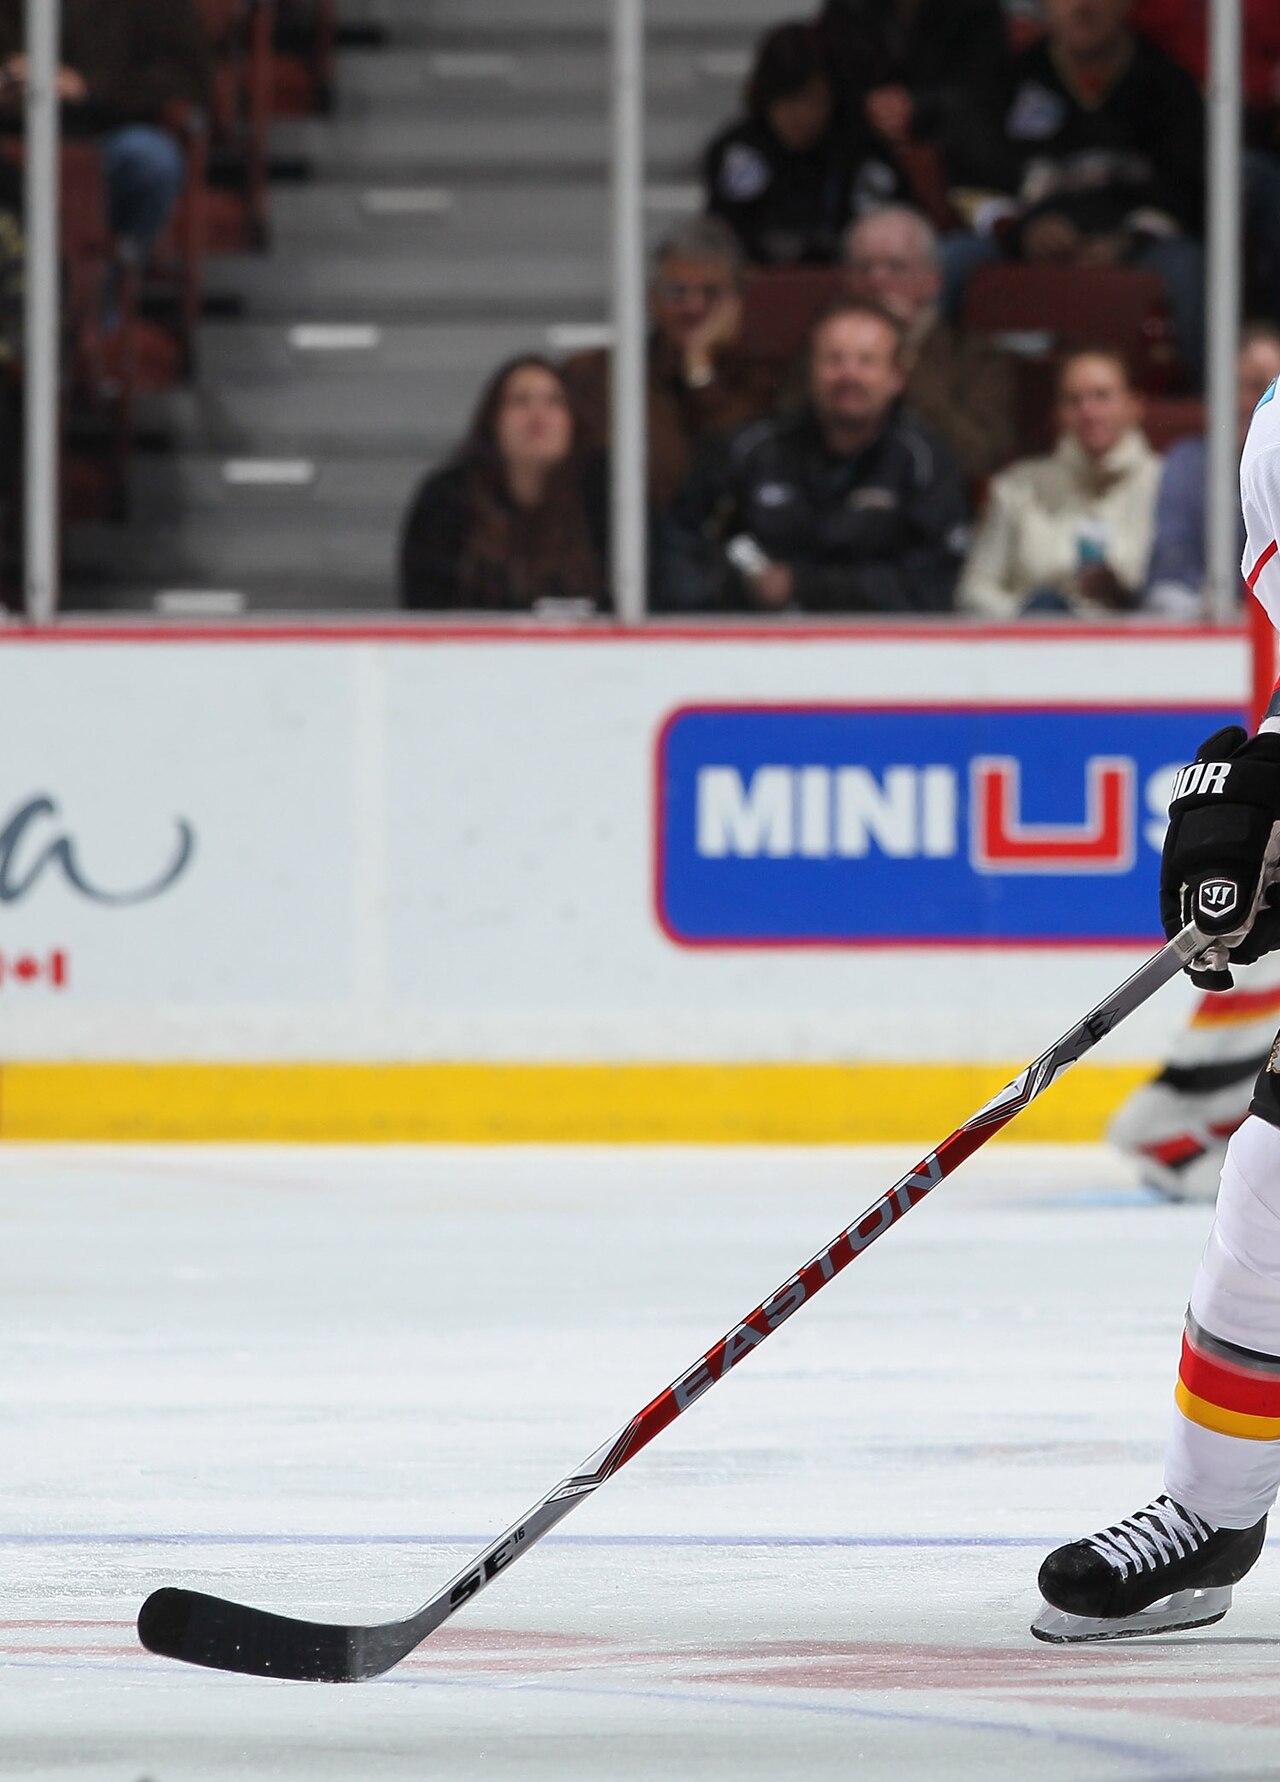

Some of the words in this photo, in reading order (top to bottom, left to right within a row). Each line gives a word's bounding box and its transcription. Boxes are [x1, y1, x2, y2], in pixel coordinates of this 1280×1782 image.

[696, 764, 957, 860] MINI
[1171, 761, 1232, 804] IOR
[671, 1152, 943, 1413] EASTON
